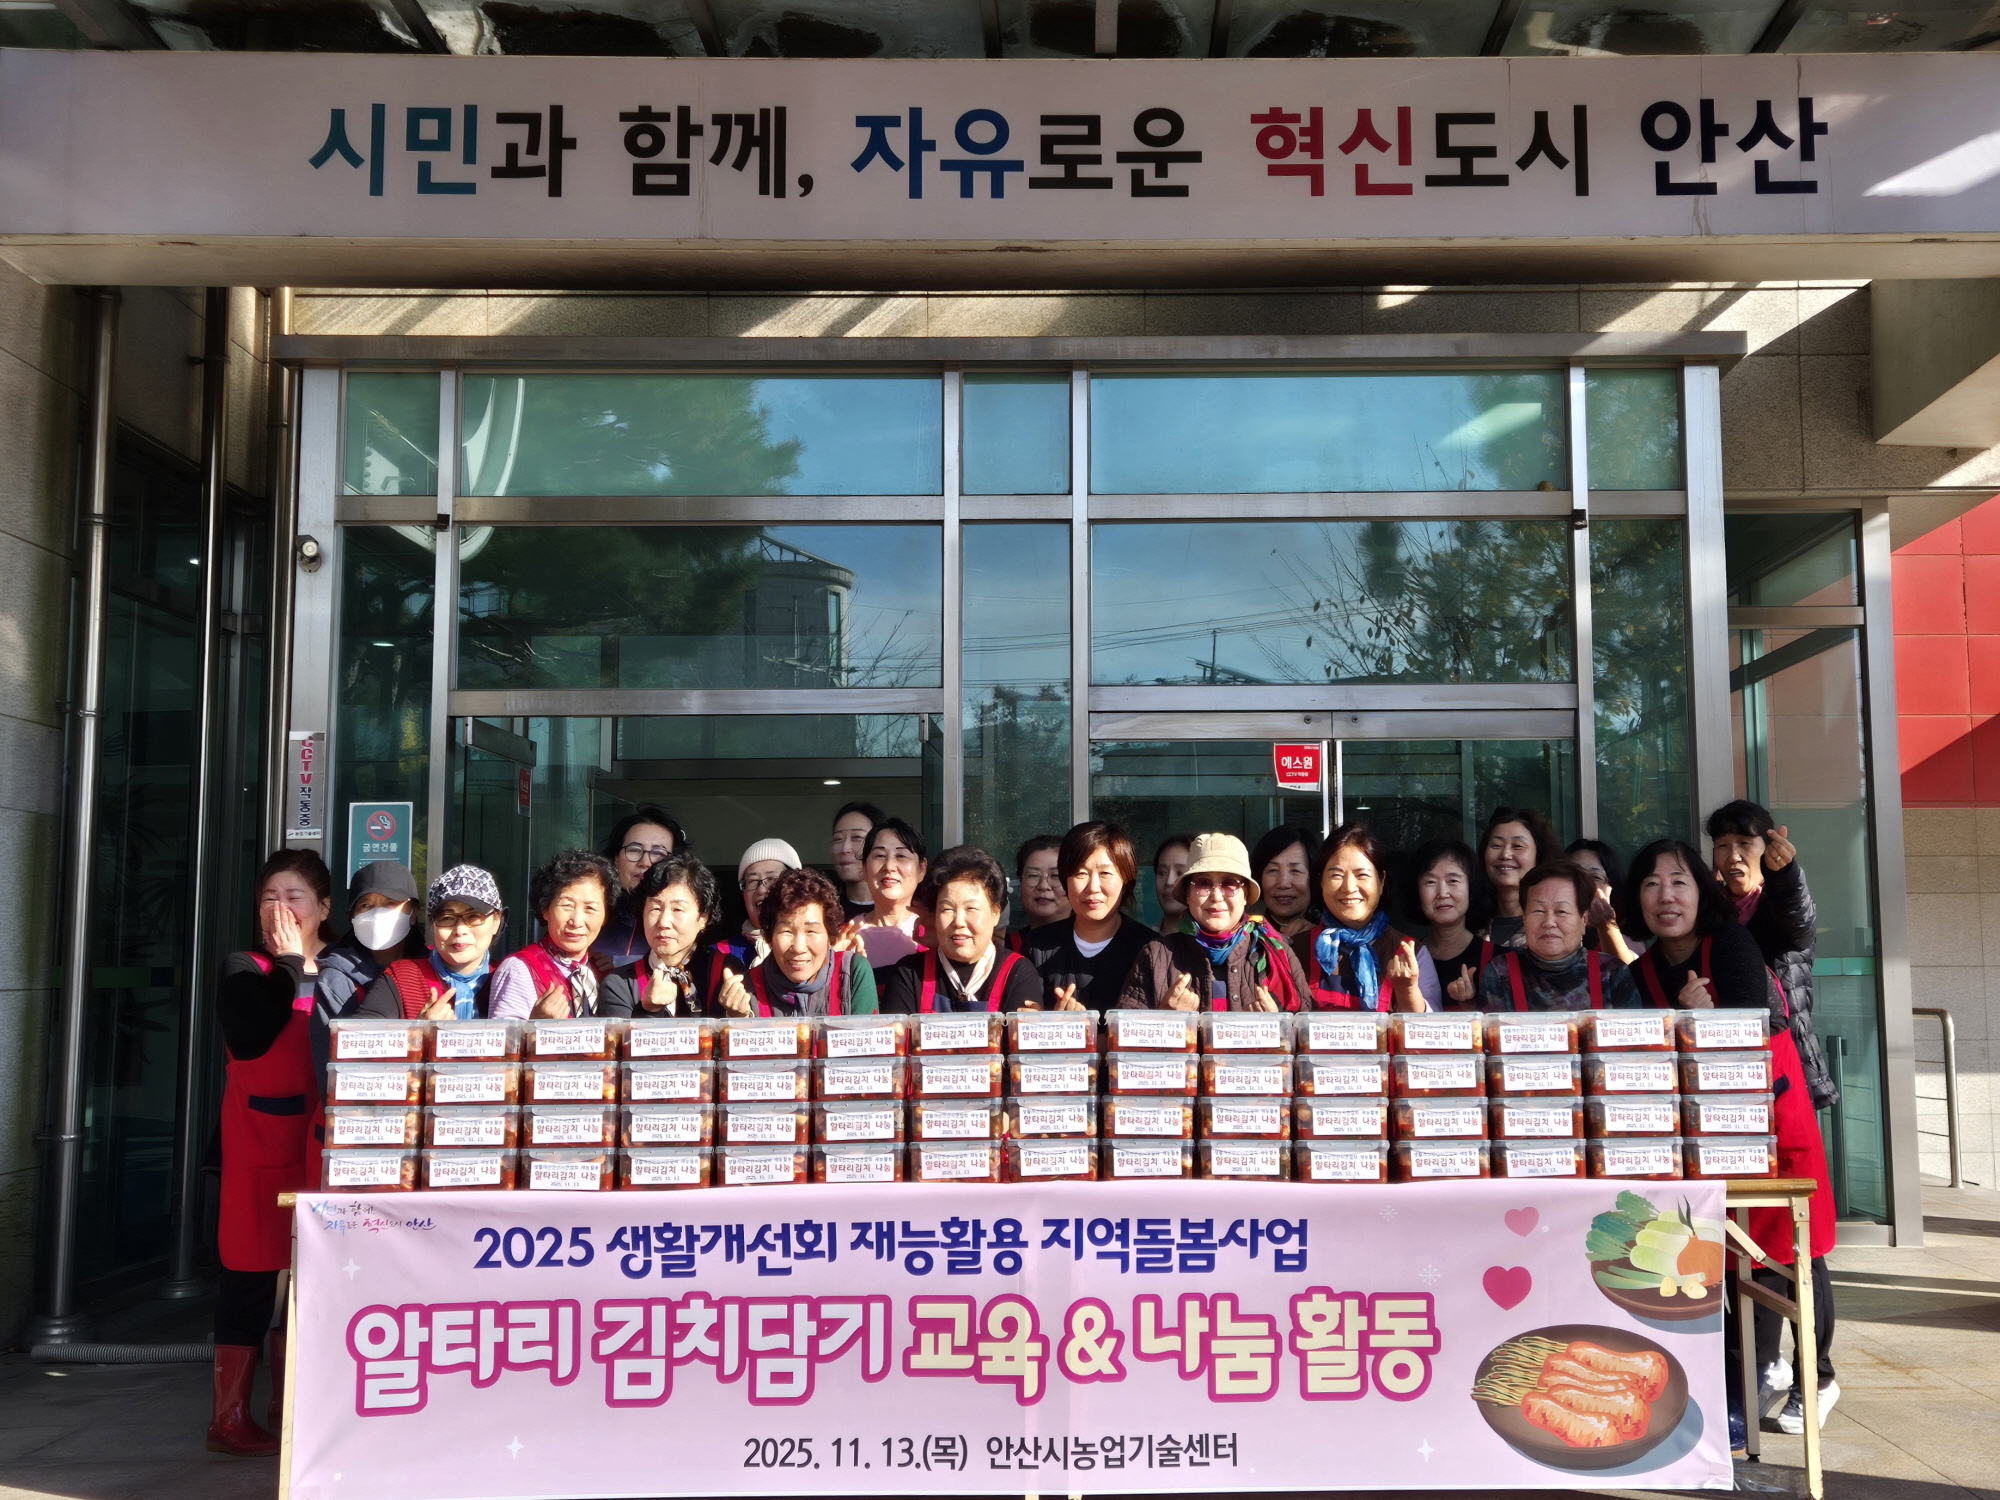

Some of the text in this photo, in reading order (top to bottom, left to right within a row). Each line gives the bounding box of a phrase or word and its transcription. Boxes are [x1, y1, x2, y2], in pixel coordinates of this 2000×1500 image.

[308, 97, 1829, 199] 시민과 함께, 자유로운 혁신도시 안산
[1281, 756, 1313, 769] 에스원
[299, 787, 313, 827] 작동중
[363, 843, 398, 853] 금연건물
[925, 1030, 964, 1040] 알타리김치
[1023, 1031, 1062, 1041] 알타리김치
[1123, 1029, 1162, 1039] 알타리김치
[1217, 1030, 1256, 1040] 알타리김치
[1314, 1031, 1353, 1041] 알타리김치
[1409, 1031, 1448, 1040] 알타리김치
[1602, 1028, 1640, 1037] 알타리김치
[1700, 1029, 1739, 1038] 알타리김치
[441, 1038, 481, 1048] 알타리김치
[540, 1036, 580, 1046] 알타리김치
[635, 1037, 675, 1047] 알타리김치
[733, 1037, 773, 1047] 알타리김치
[832, 1038, 871, 1048] 알타리김치
[1505, 1034, 1544, 1043] 알타리김치
[342, 1039, 383, 1050] 알타리김치
[927, 1075, 966, 1084] 알타리김치
[1025, 1074, 1065, 1083] 알타리김치
[1122, 1070, 1162, 1080] 알타리김치
[1413, 1070, 1452, 1079] 알타리김치
[1509, 1072, 1548, 1082] 알타리김치
[1610, 1072, 1649, 1081] 알타리김치
[1704, 1071, 1743, 1080] 알타리김치
[636, 1080, 676, 1090] 알타리김치
[829, 1075, 868, 1085] 알타리김치
[1220, 1076, 1259, 1085] 알타리김치
[1318, 1075, 1358, 1085] 알타리김치
[341, 1081, 382, 1091] 알타리김치
[440, 1083, 480, 1093] 알타리김치
[539, 1081, 579, 1091] 알타리김치
[732, 1081, 772, 1092] 알타리김치
[1024, 1114, 1064, 1124] 알타리김치
[1119, 1116, 1159, 1126] 알타리김치
[1217, 1114, 1256, 1124] 알타리김치
[1318, 1116, 1357, 1126] 알타리김치
[1419, 1118, 1458, 1127] 알타리김치
[1509, 1117, 1549, 1127] 알타리김치
[1610, 1113, 1650, 1122] 알타리김치
[1705, 1114, 1745, 1124] 알타리김치
[636, 1123, 676, 1133] 알타리김치
[732, 1122, 772, 1134] 알타리김치
[831, 1121, 870, 1131] 알타리김치
[926, 1119, 966, 1129] 알타리김치
[339, 1125, 380, 1136] 알타리김치
[439, 1126, 480, 1137] 알타리김치
[537, 1124, 578, 1135] 알타리김치
[925, 1159, 966, 1171] 알타리김치
[1025, 1157, 1065, 1167] 알타리김치
[1118, 1157, 1158, 1167] 알타리김치
[1216, 1156, 1256, 1166] 알타리김치
[1416, 1158, 1456, 1167] 알타리김치
[1511, 1158, 1551, 1168] 알타리김치
[1609, 1156, 1649, 1166] 알타리김치
[1705, 1155, 1744, 1165] 알타리김치
[635, 1165, 676, 1175] 알타리김치
[729, 1164, 770, 1175] 알타리김치
[830, 1163, 870, 1173] 알타리김치
[1316, 1161, 1356, 1170] 알타리김치
[334, 1167, 375, 1176] 알타리김치
[434, 1167, 475, 1177] 알타리김치
[535, 1171, 576, 1181] 알타리김치
[406, 1218, 436, 1230] 안산
[473, 1216, 1308, 1279] 2025 생활개선회 재능활용 지역돌봄사업
[346, 1286, 1440, 1417] 알타리 김치담기 교육 & 나눔 활동
[744, 1433, 1238, 1471] 2025. 11. 13.(목) 안산시농업기술센터
